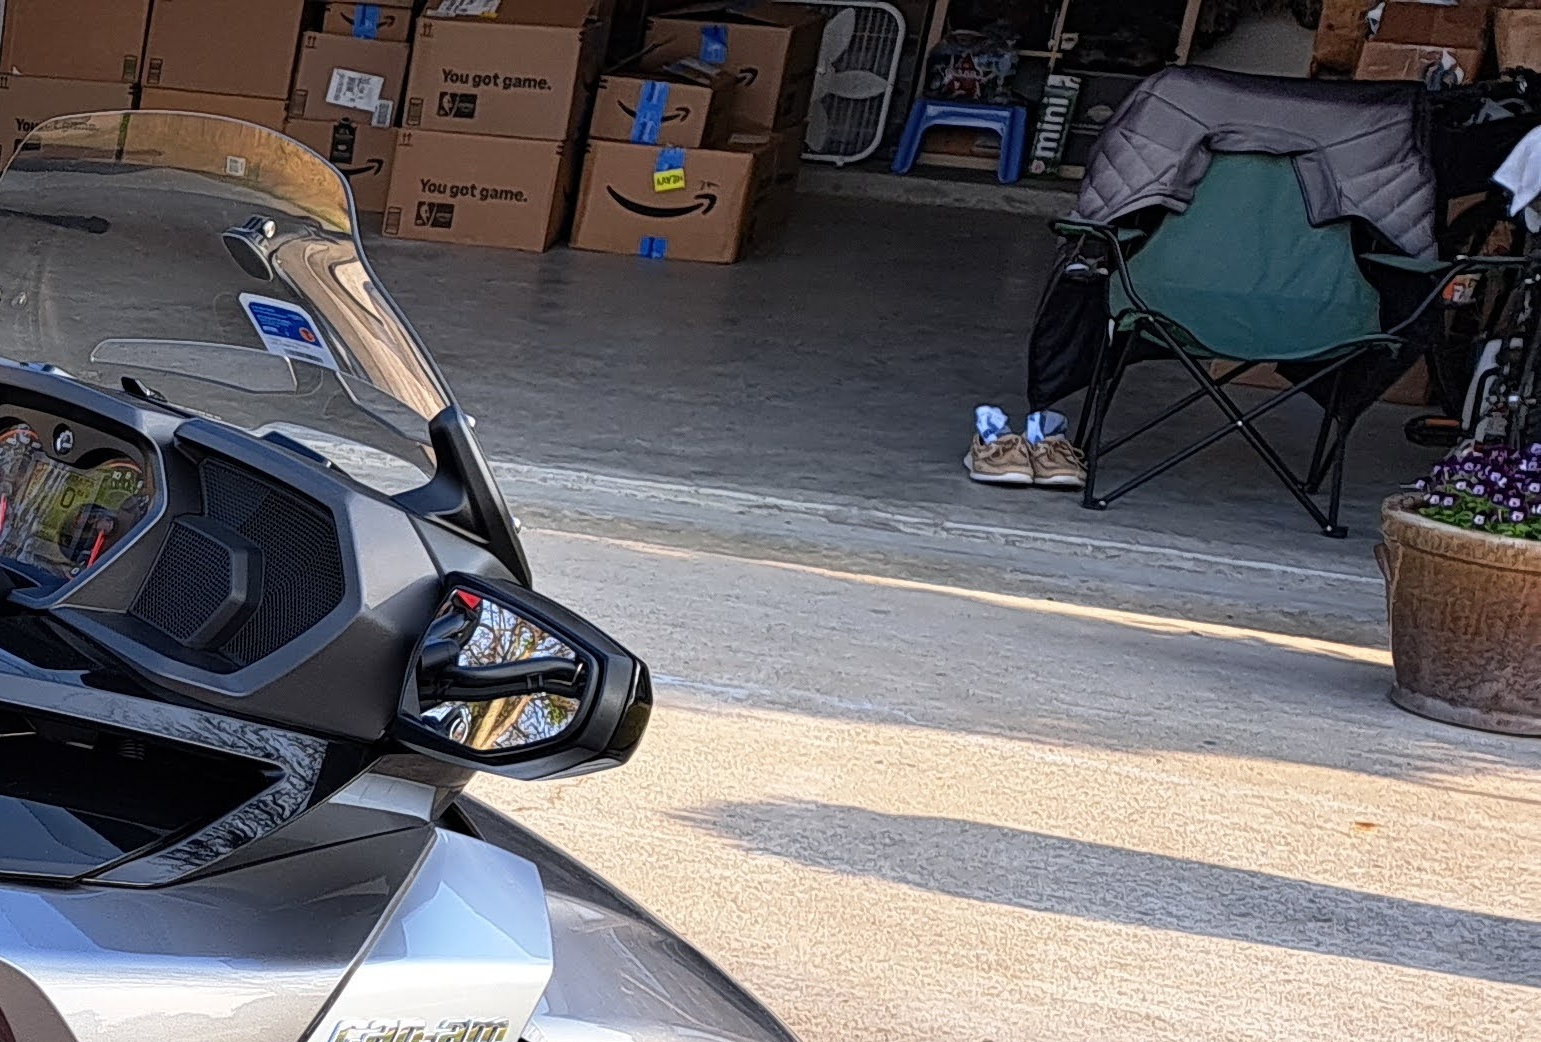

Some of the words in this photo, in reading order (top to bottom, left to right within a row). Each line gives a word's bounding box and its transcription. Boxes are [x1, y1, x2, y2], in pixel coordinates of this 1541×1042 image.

[442, 68, 468, 85] You
[472, 73, 500, 89] got
[502, 76, 552, 91] game.
[1034, 97, 1069, 159] mini
[420, 178, 447, 195] You
[449, 183, 477, 198] got
[479, 187, 528, 203] game.
